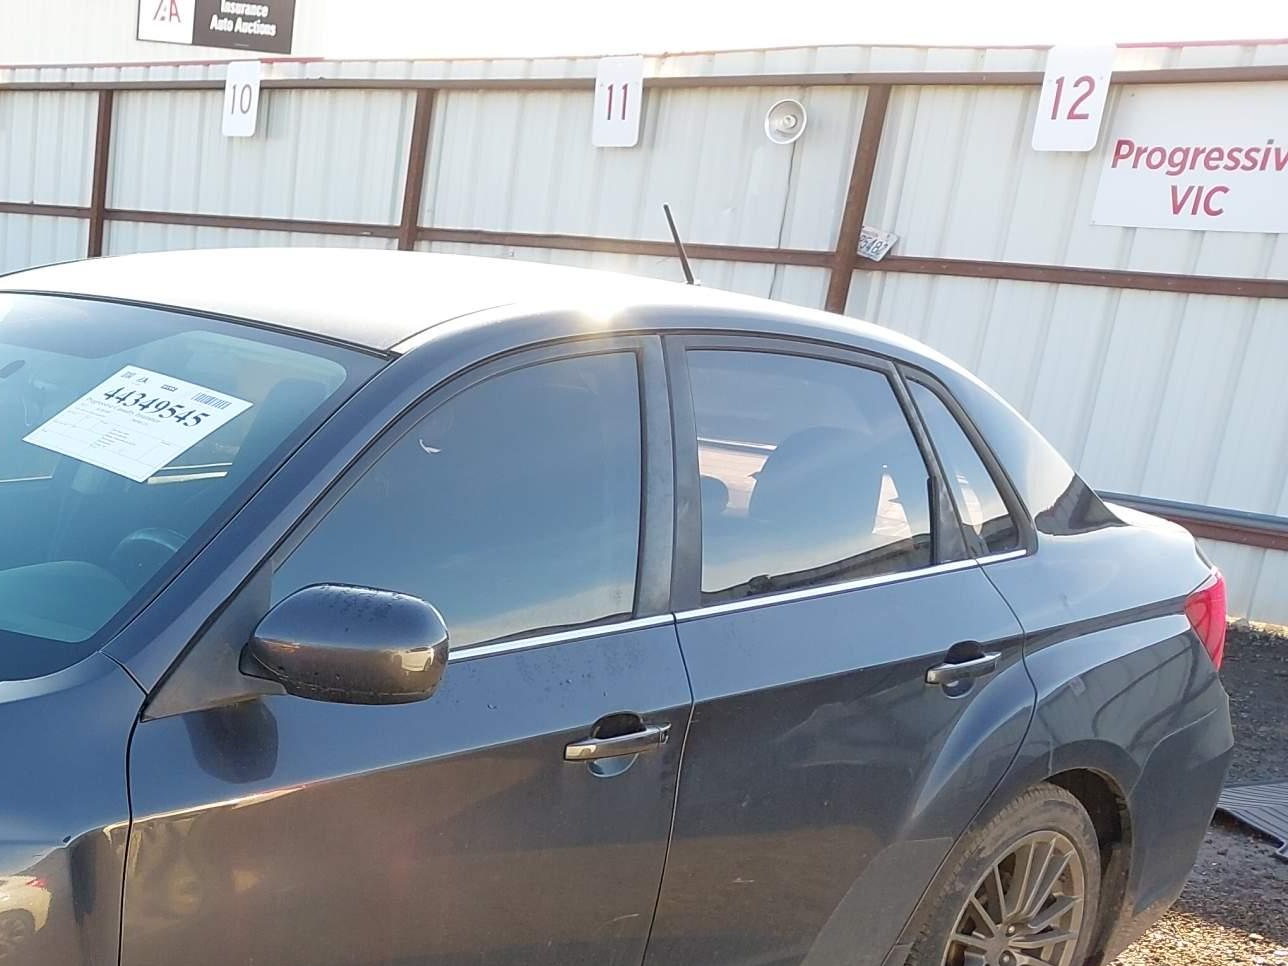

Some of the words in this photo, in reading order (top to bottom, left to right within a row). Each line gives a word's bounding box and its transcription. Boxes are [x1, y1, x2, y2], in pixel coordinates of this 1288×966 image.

[210, 14, 233, 32] Auto
[234, 17, 277, 36] Auctions
[220, 0, 269, 18] Insurance
[230, 84, 252, 115] 10
[607, 83, 629, 120] 11
[1050, 75, 1097, 120] 12
[1111, 139, 1288, 177] Progressiv
[1170, 185, 1231, 217] VIC
[103, 386, 211, 428] 44349545
